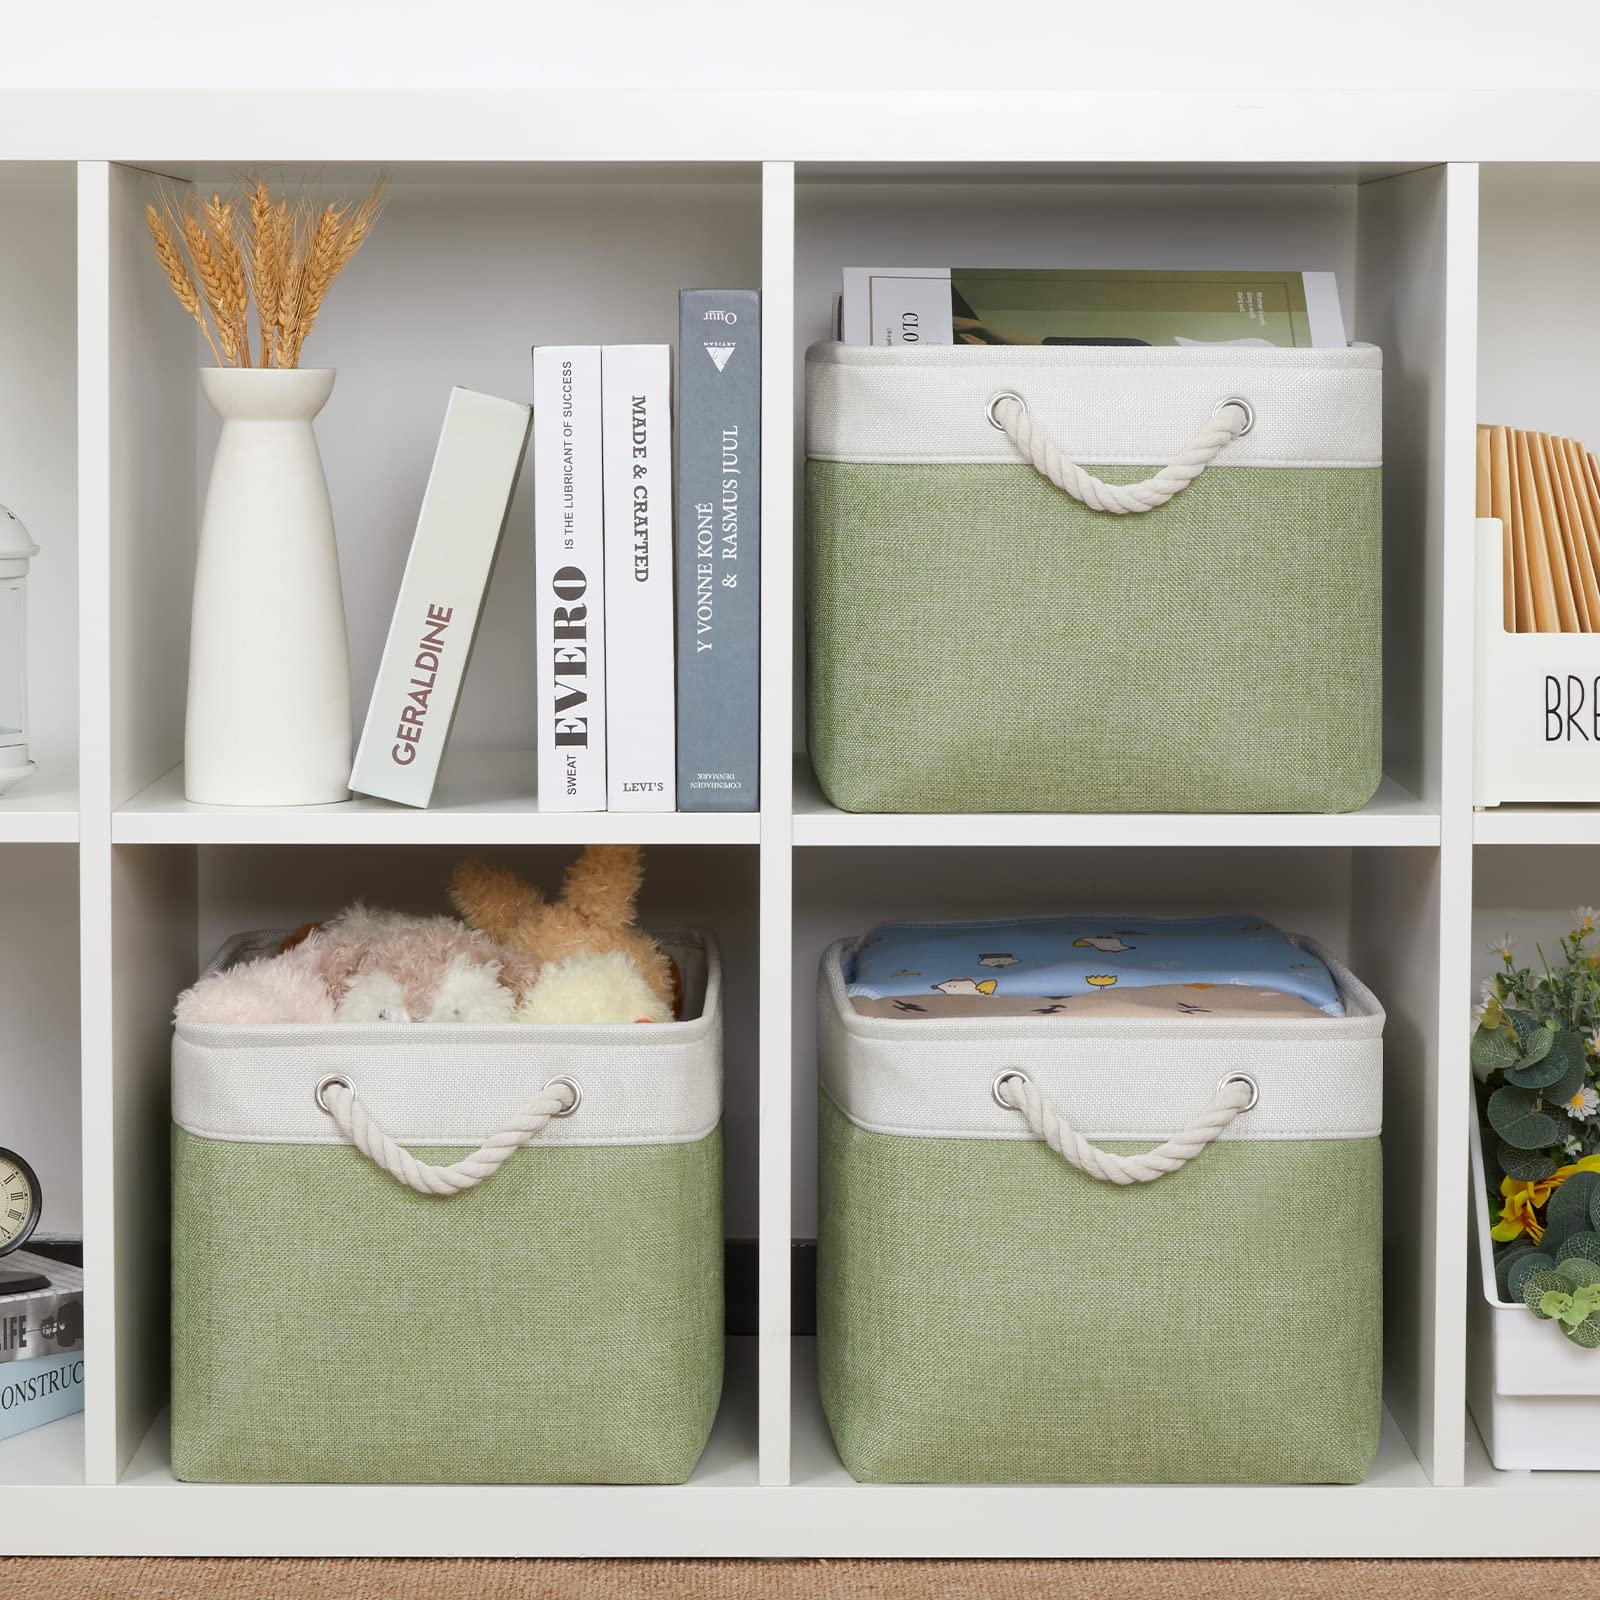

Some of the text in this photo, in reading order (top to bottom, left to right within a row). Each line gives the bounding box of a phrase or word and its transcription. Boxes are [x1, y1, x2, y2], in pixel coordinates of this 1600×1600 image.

[703, 310, 737, 325] Ouur
[902, 312, 919, 345] CLO
[562, 360, 574, 550] IS THE LUBRICANT OF SUCCESS
[631, 395, 649, 583] MADE & CRAFTED
[721, 425, 741, 588] & RASMUS JUUL
[694, 502, 713, 558] KONÉ
[552, 565, 588, 750] EVERO
[391, 603, 454, 766] GERALDINE
[566, 754, 577, 796] SWEAT
[623, 782, 664, 792] LEVI'S
[0, 1315, 27, 1351] IFE
[0, 1360, 83, 1410] ONSTRUC
